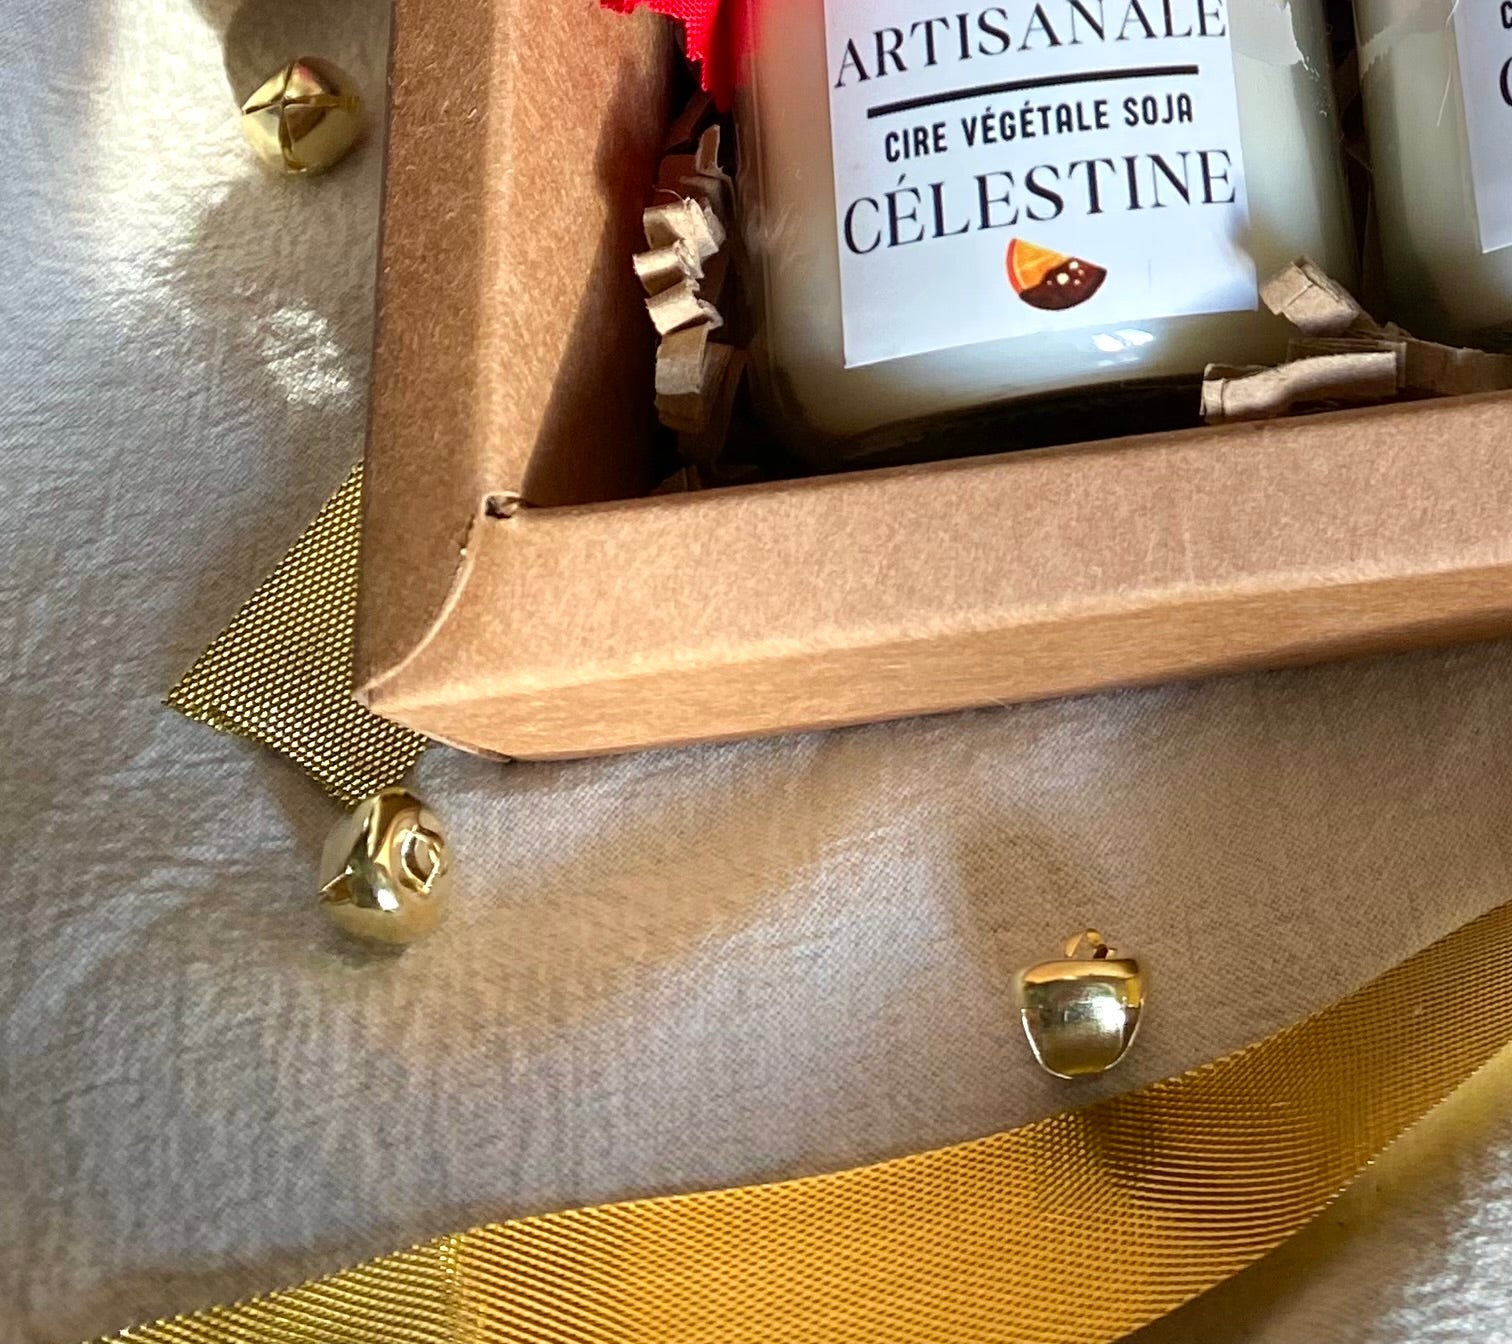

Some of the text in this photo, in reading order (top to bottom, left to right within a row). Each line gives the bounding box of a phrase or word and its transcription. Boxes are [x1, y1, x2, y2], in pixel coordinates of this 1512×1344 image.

[884, 92, 1194, 163] CIRE VÉGÉTALE SOJA
[843, 149, 1236, 256] CÉLESTINE
